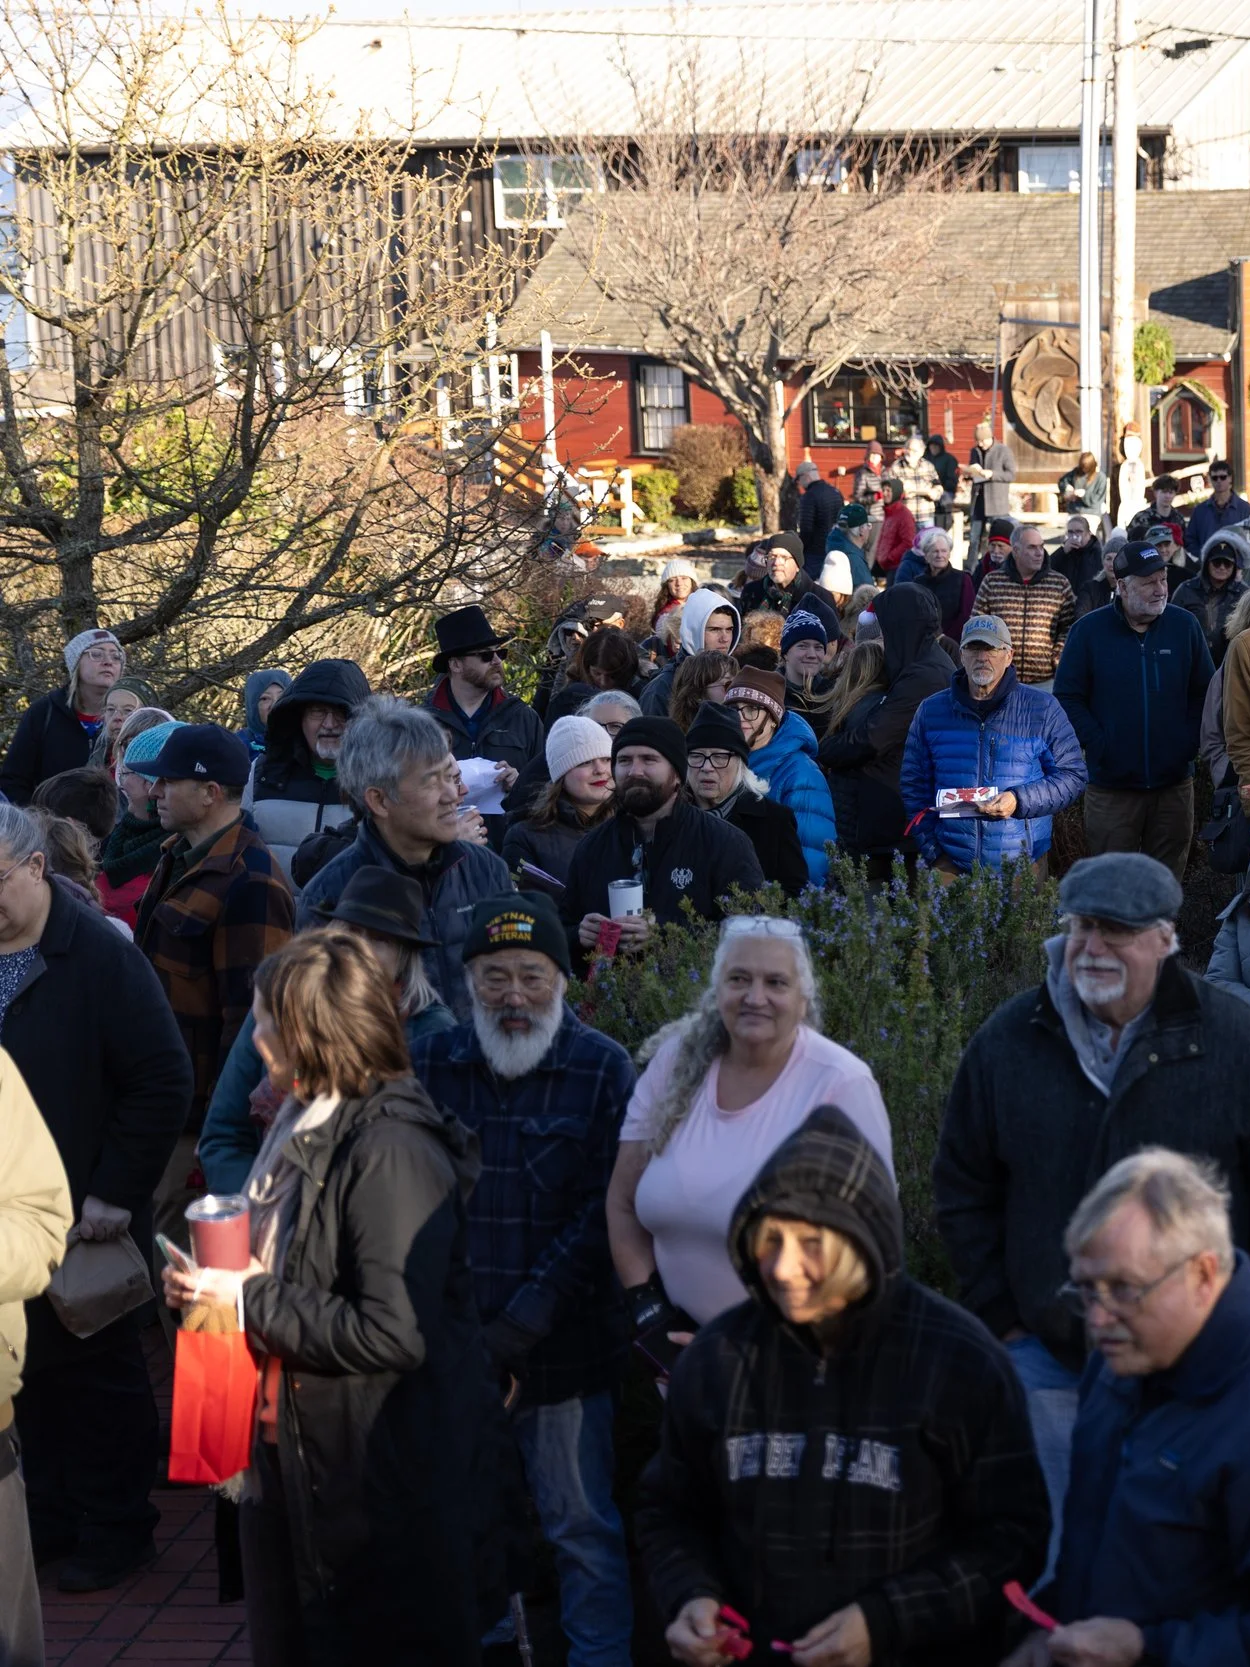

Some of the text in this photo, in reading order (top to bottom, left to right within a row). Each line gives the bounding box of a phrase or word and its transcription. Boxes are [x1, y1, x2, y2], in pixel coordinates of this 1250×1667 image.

[965, 620, 998, 634] ALASKA
[485, 911, 535, 927] VIETNAM
[489, 931, 532, 943] VETERAN
